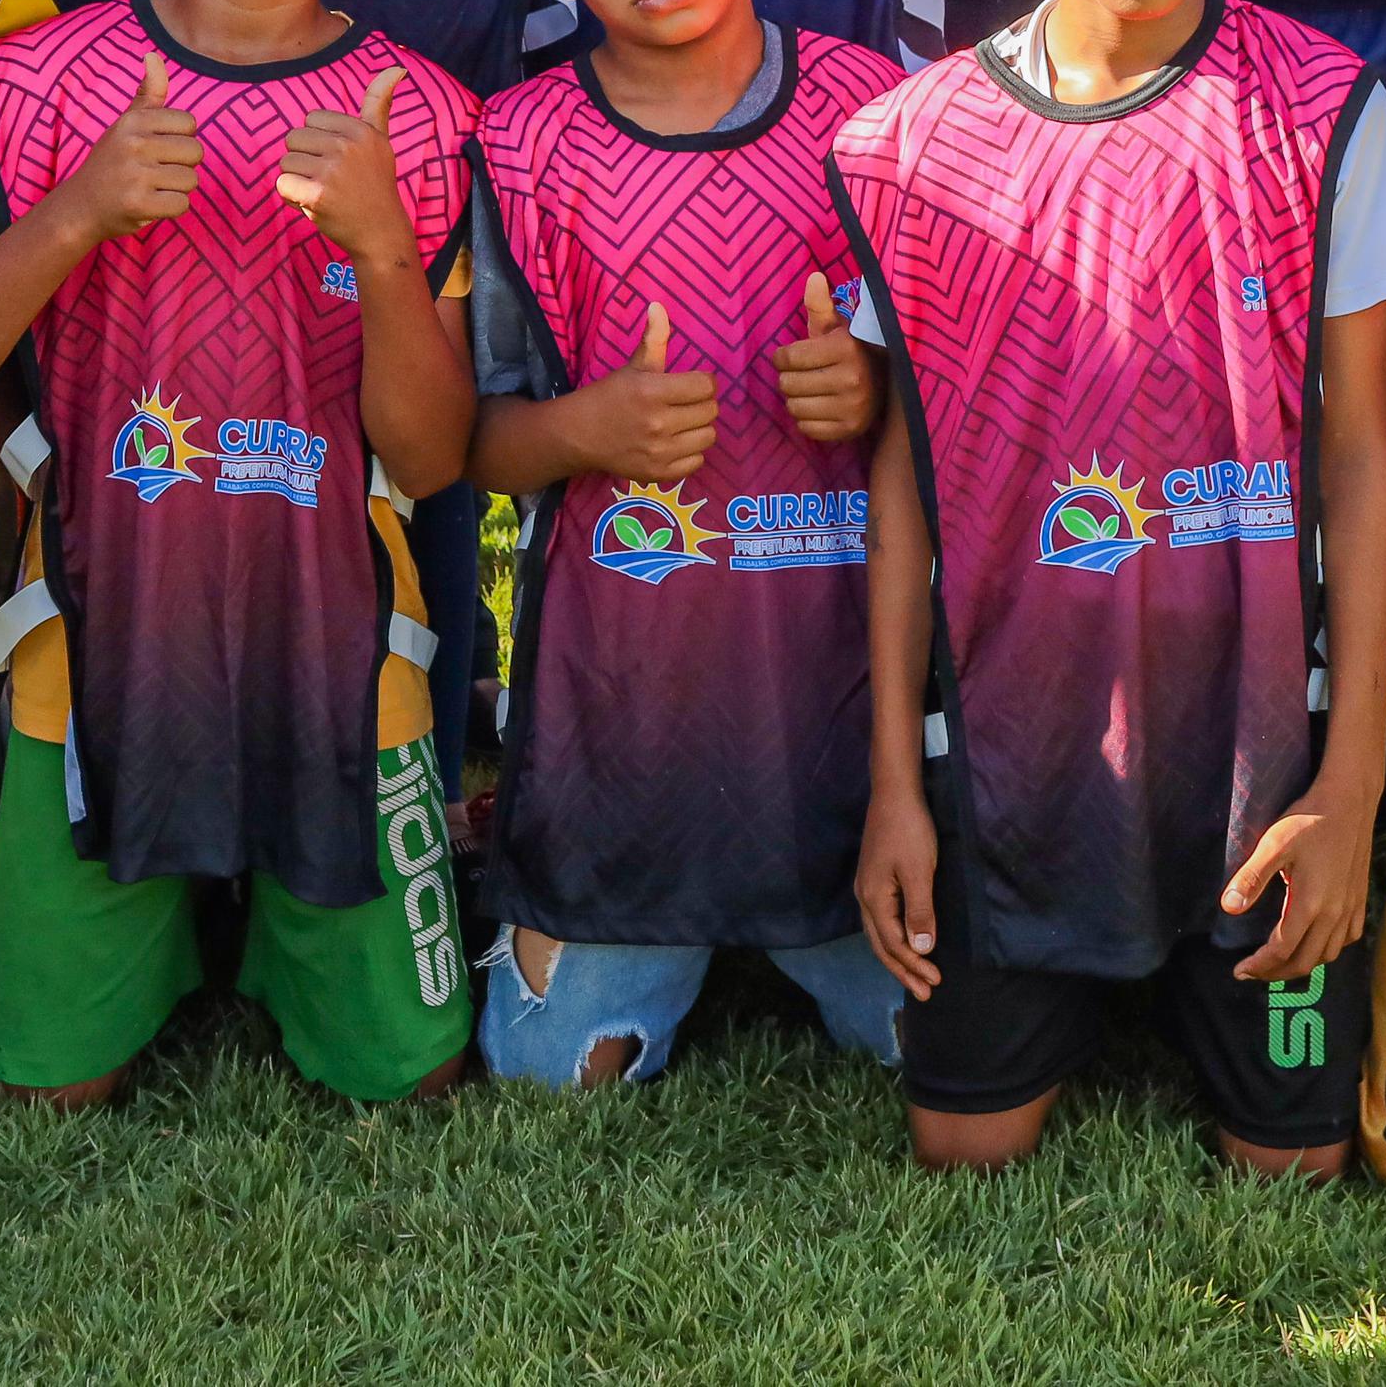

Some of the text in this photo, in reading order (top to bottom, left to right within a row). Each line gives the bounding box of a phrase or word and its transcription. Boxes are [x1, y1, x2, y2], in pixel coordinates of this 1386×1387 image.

[221, 462, 288, 483] PREFEITURA
[726, 490, 869, 532] CURRAIS
[734, 536, 804, 556] PREFEITURA
